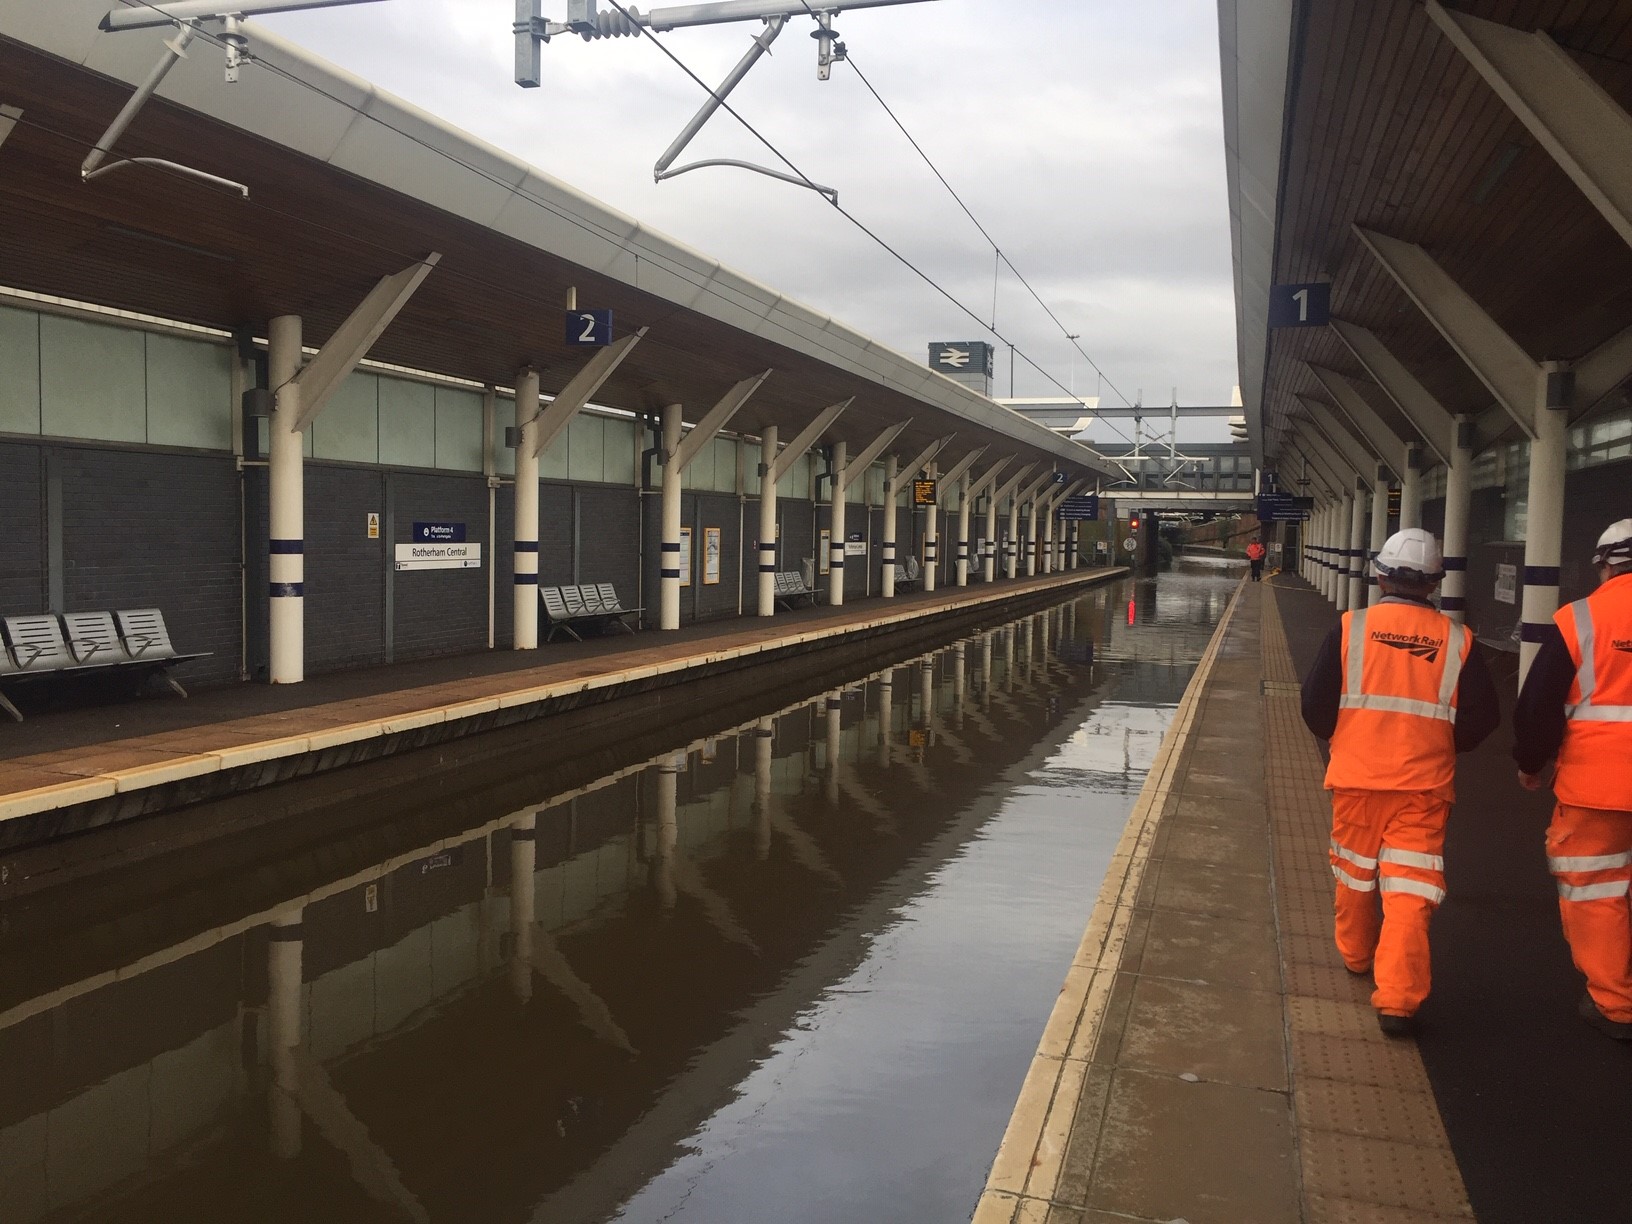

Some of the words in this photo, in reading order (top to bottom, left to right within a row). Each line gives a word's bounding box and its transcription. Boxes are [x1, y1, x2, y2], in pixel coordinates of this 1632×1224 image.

[1292, 289, 1307, 321] 1
[579, 313, 595, 342] 2
[1056, 473, 1063, 482] 2
[1267, 473, 1273, 482] 1
[430, 526, 450, 534] Platform
[412, 548, 446, 557] Rotherham
[446, 547, 467, 557] Central
